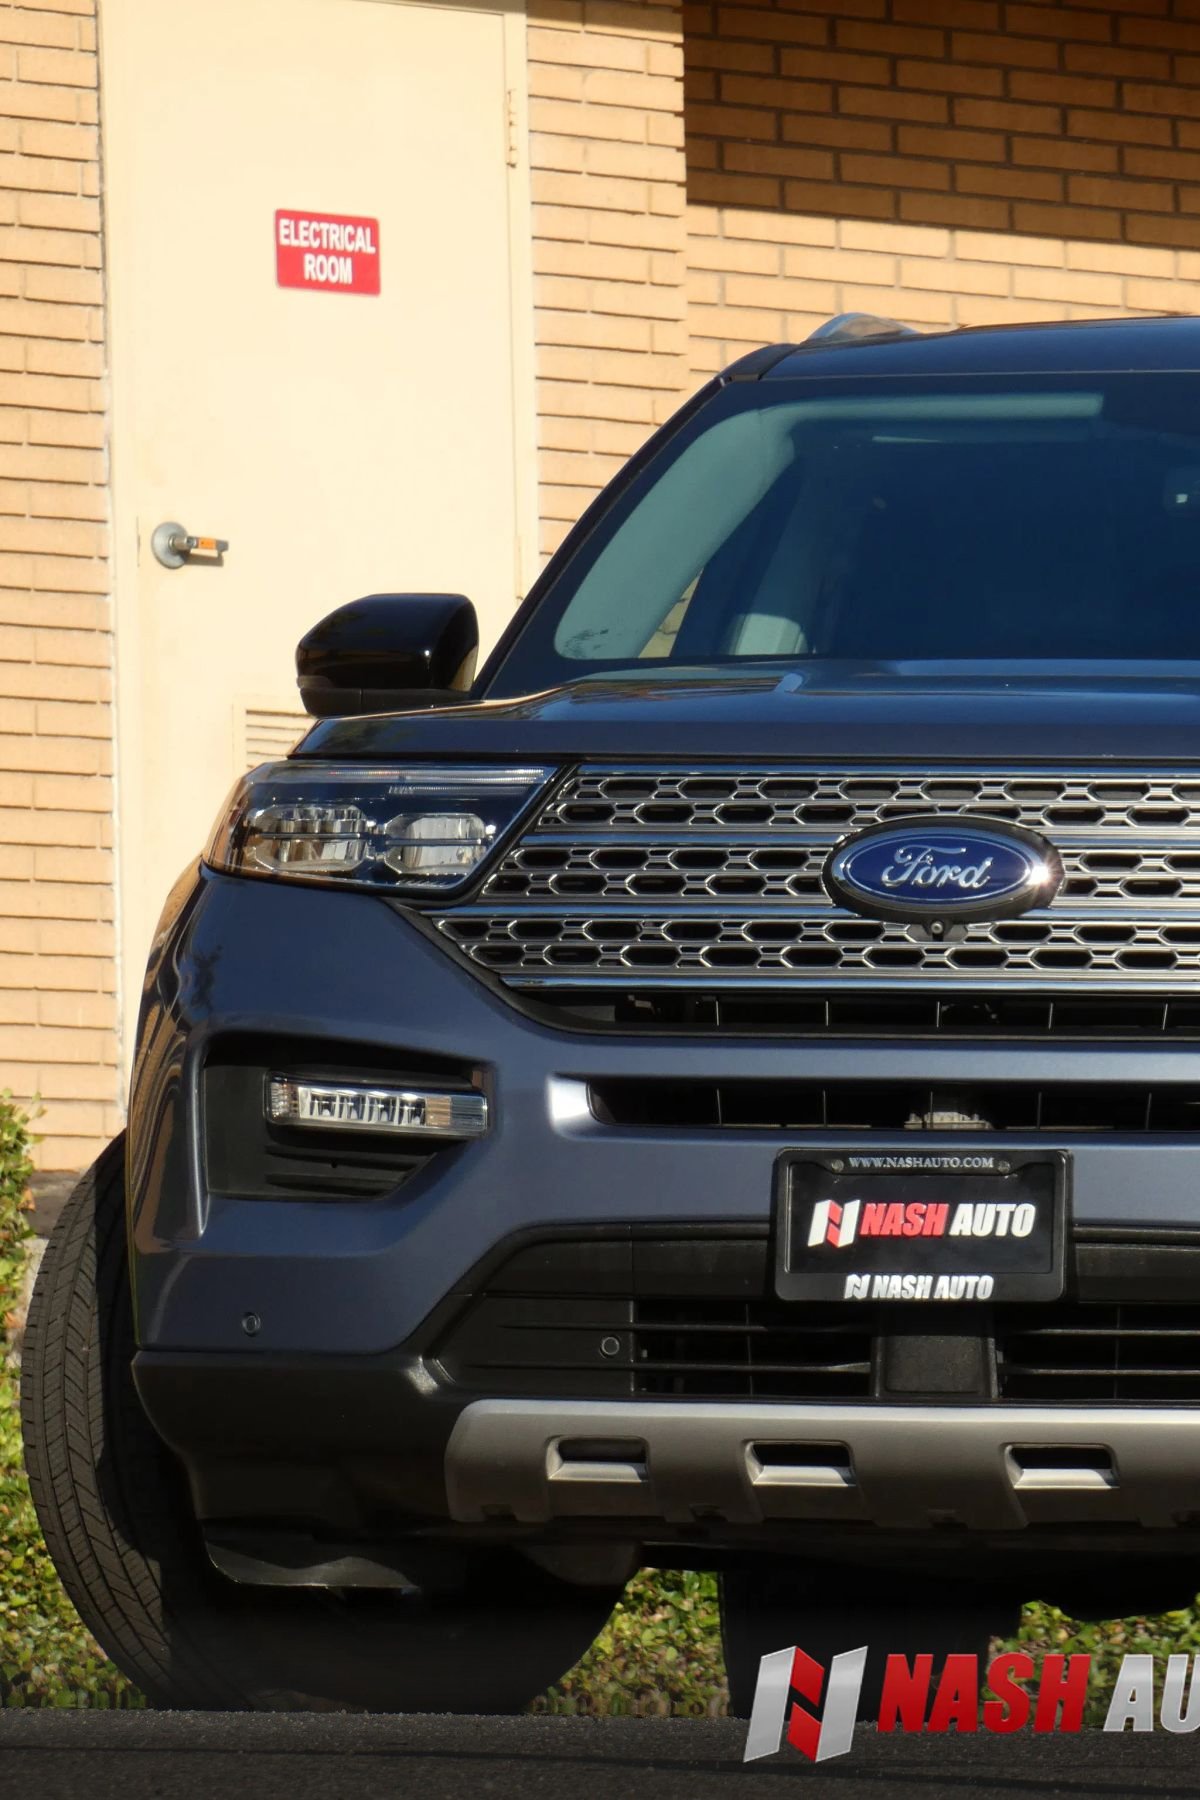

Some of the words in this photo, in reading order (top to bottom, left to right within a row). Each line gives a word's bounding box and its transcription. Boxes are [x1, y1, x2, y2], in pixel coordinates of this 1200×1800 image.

[279, 218, 376, 254] ELECTRICAL
[304, 253, 353, 285] ROOM
[881, 844, 994, 889] Ford
[848, 1157, 995, 1169] WWW.NASHAUTO.COM
[859, 1202, 950, 1237] NASH
[949, 1203, 1037, 1238] AUTO
[871, 1275, 934, 1300] NASH
[933, 1275, 995, 1300] AUTO
